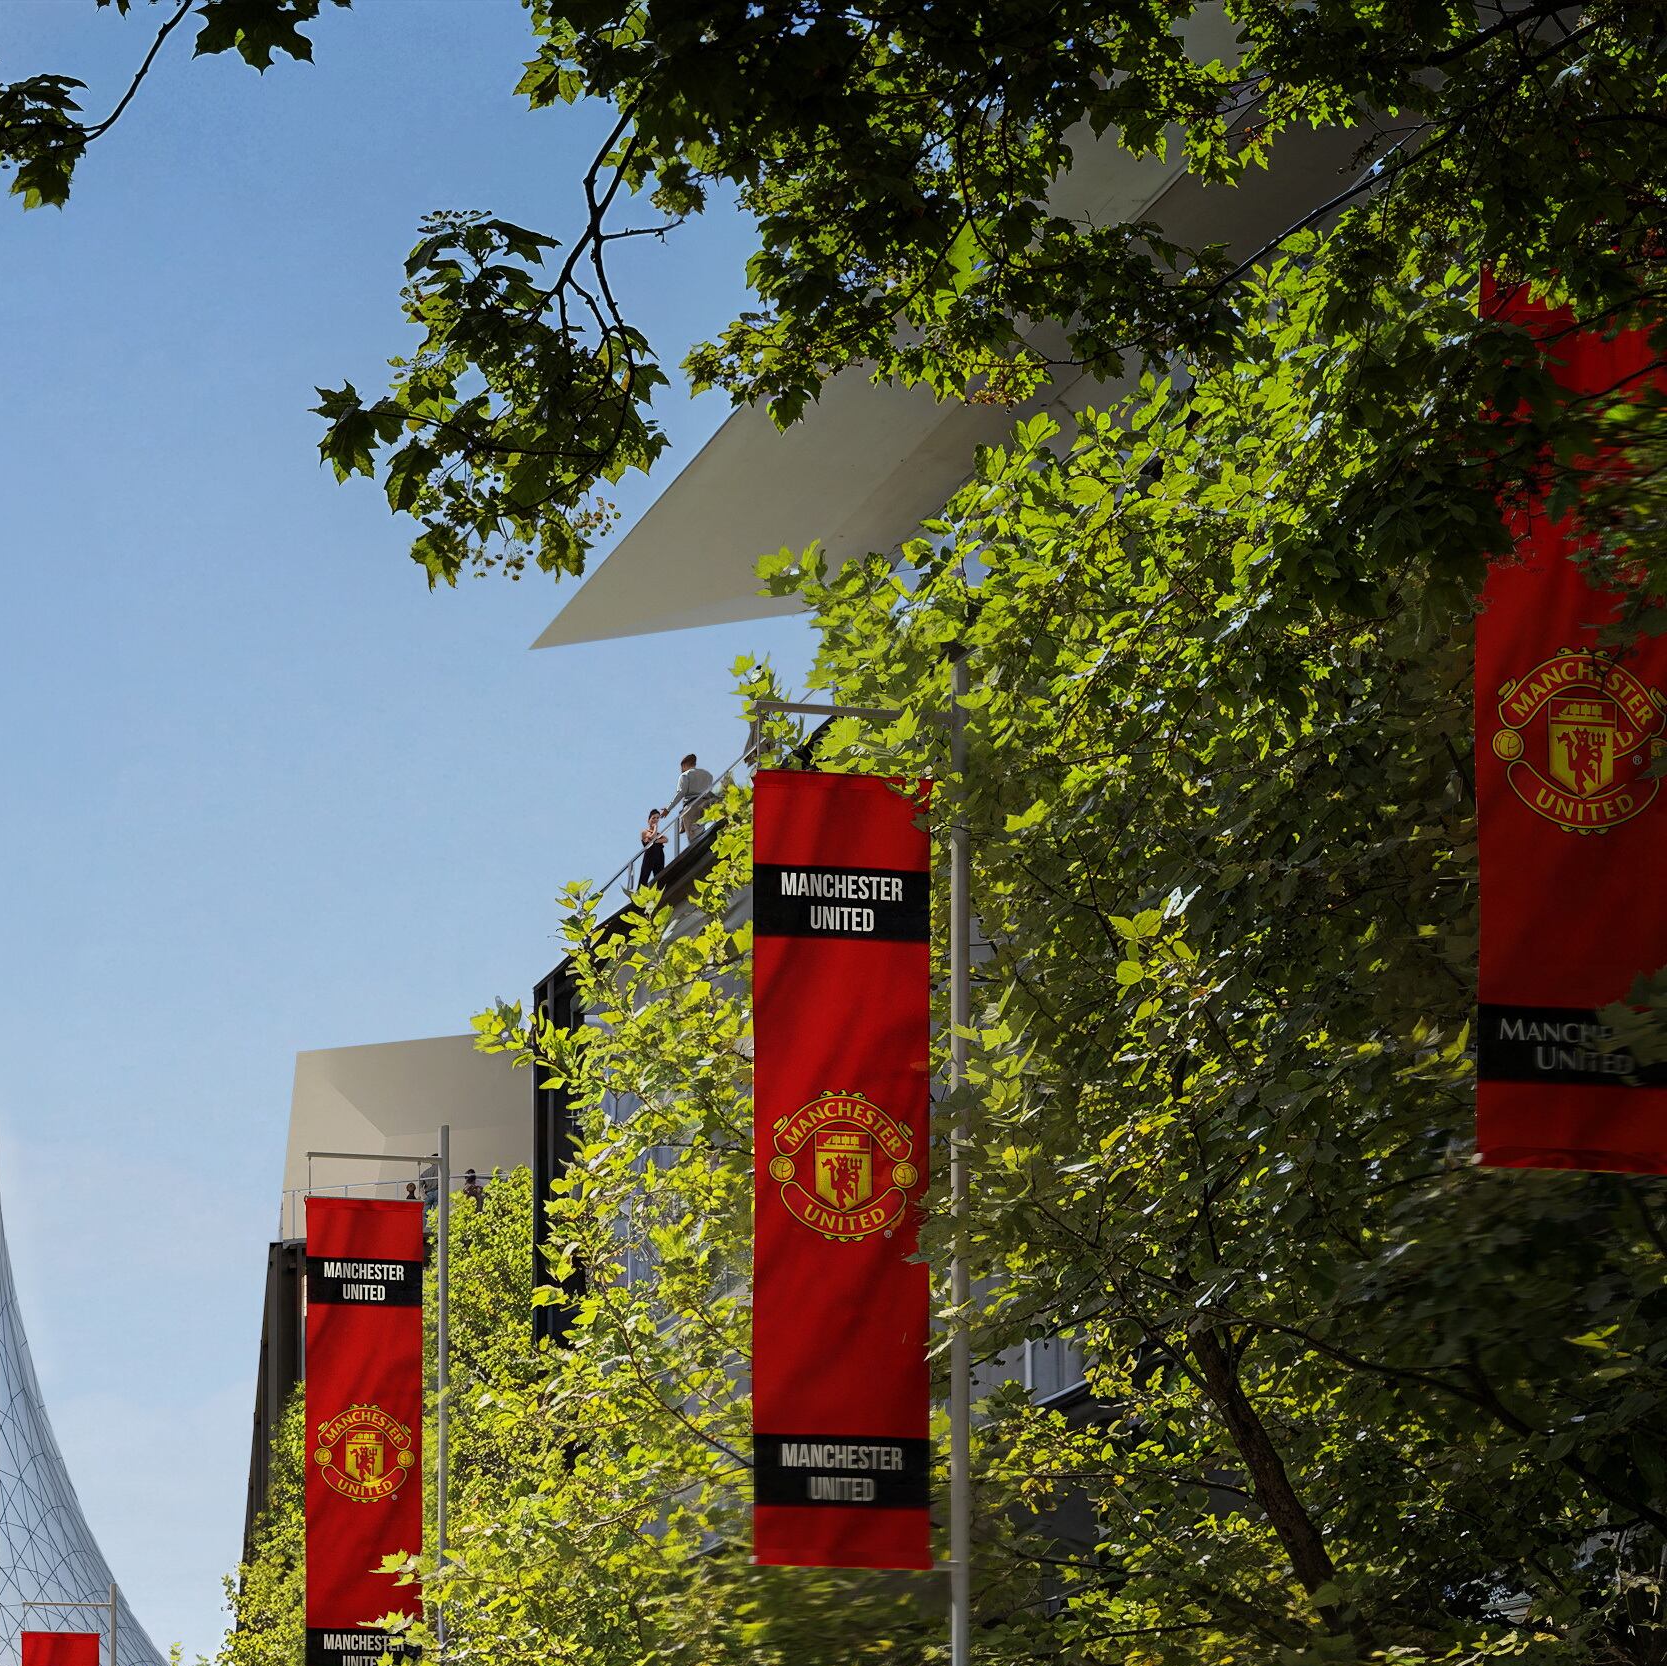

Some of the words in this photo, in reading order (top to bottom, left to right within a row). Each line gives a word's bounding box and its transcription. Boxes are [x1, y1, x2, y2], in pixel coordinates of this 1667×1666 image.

[1535, 787, 1634, 822] UNITED
[780, 872, 903, 901] MANCHESTER
[809, 905, 875, 932] UNITED
[783, 1101, 903, 1155] MANCHESTER
[803, 1204, 886, 1232] UNITED
[323, 1261, 405, 1281] MANCHESTER
[342, 1283, 386, 1301] UNITED
[324, 1411, 405, 1445] MANCHESTER
[780, 1443, 903, 1471] MANCHESTER
[336, 1479, 393, 1497] UNITED
[809, 1476, 875, 1502] UNITED
